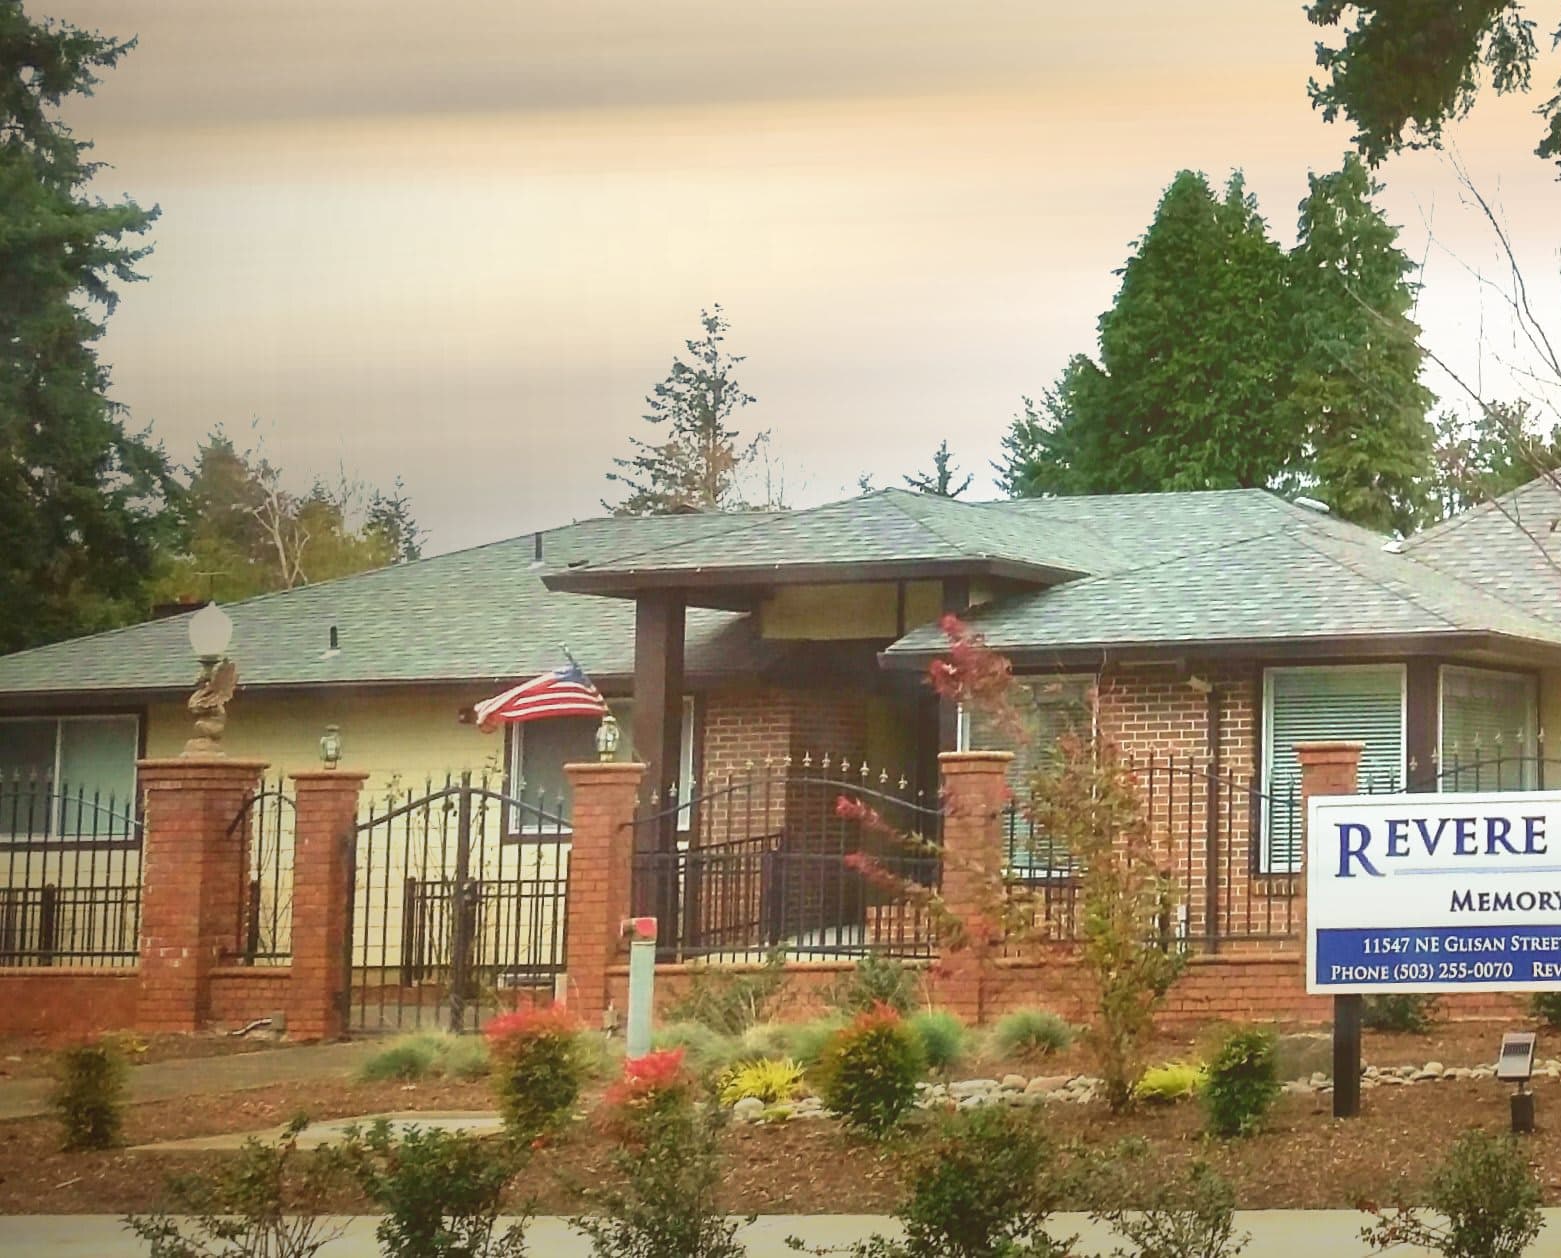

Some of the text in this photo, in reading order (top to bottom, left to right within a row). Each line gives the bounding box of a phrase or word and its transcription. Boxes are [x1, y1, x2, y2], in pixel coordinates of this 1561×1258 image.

[1333, 813, 1548, 878] REVERE
[1363, 936, 1410, 954] 11547
[1415, 936, 1439, 953] NE
[1444, 934, 1504, 952] GLISAN
[1331, 964, 1389, 981] PHONE
[1393, 962, 1434, 981] (503)
[1439, 961, 1513, 979] 255-0070
